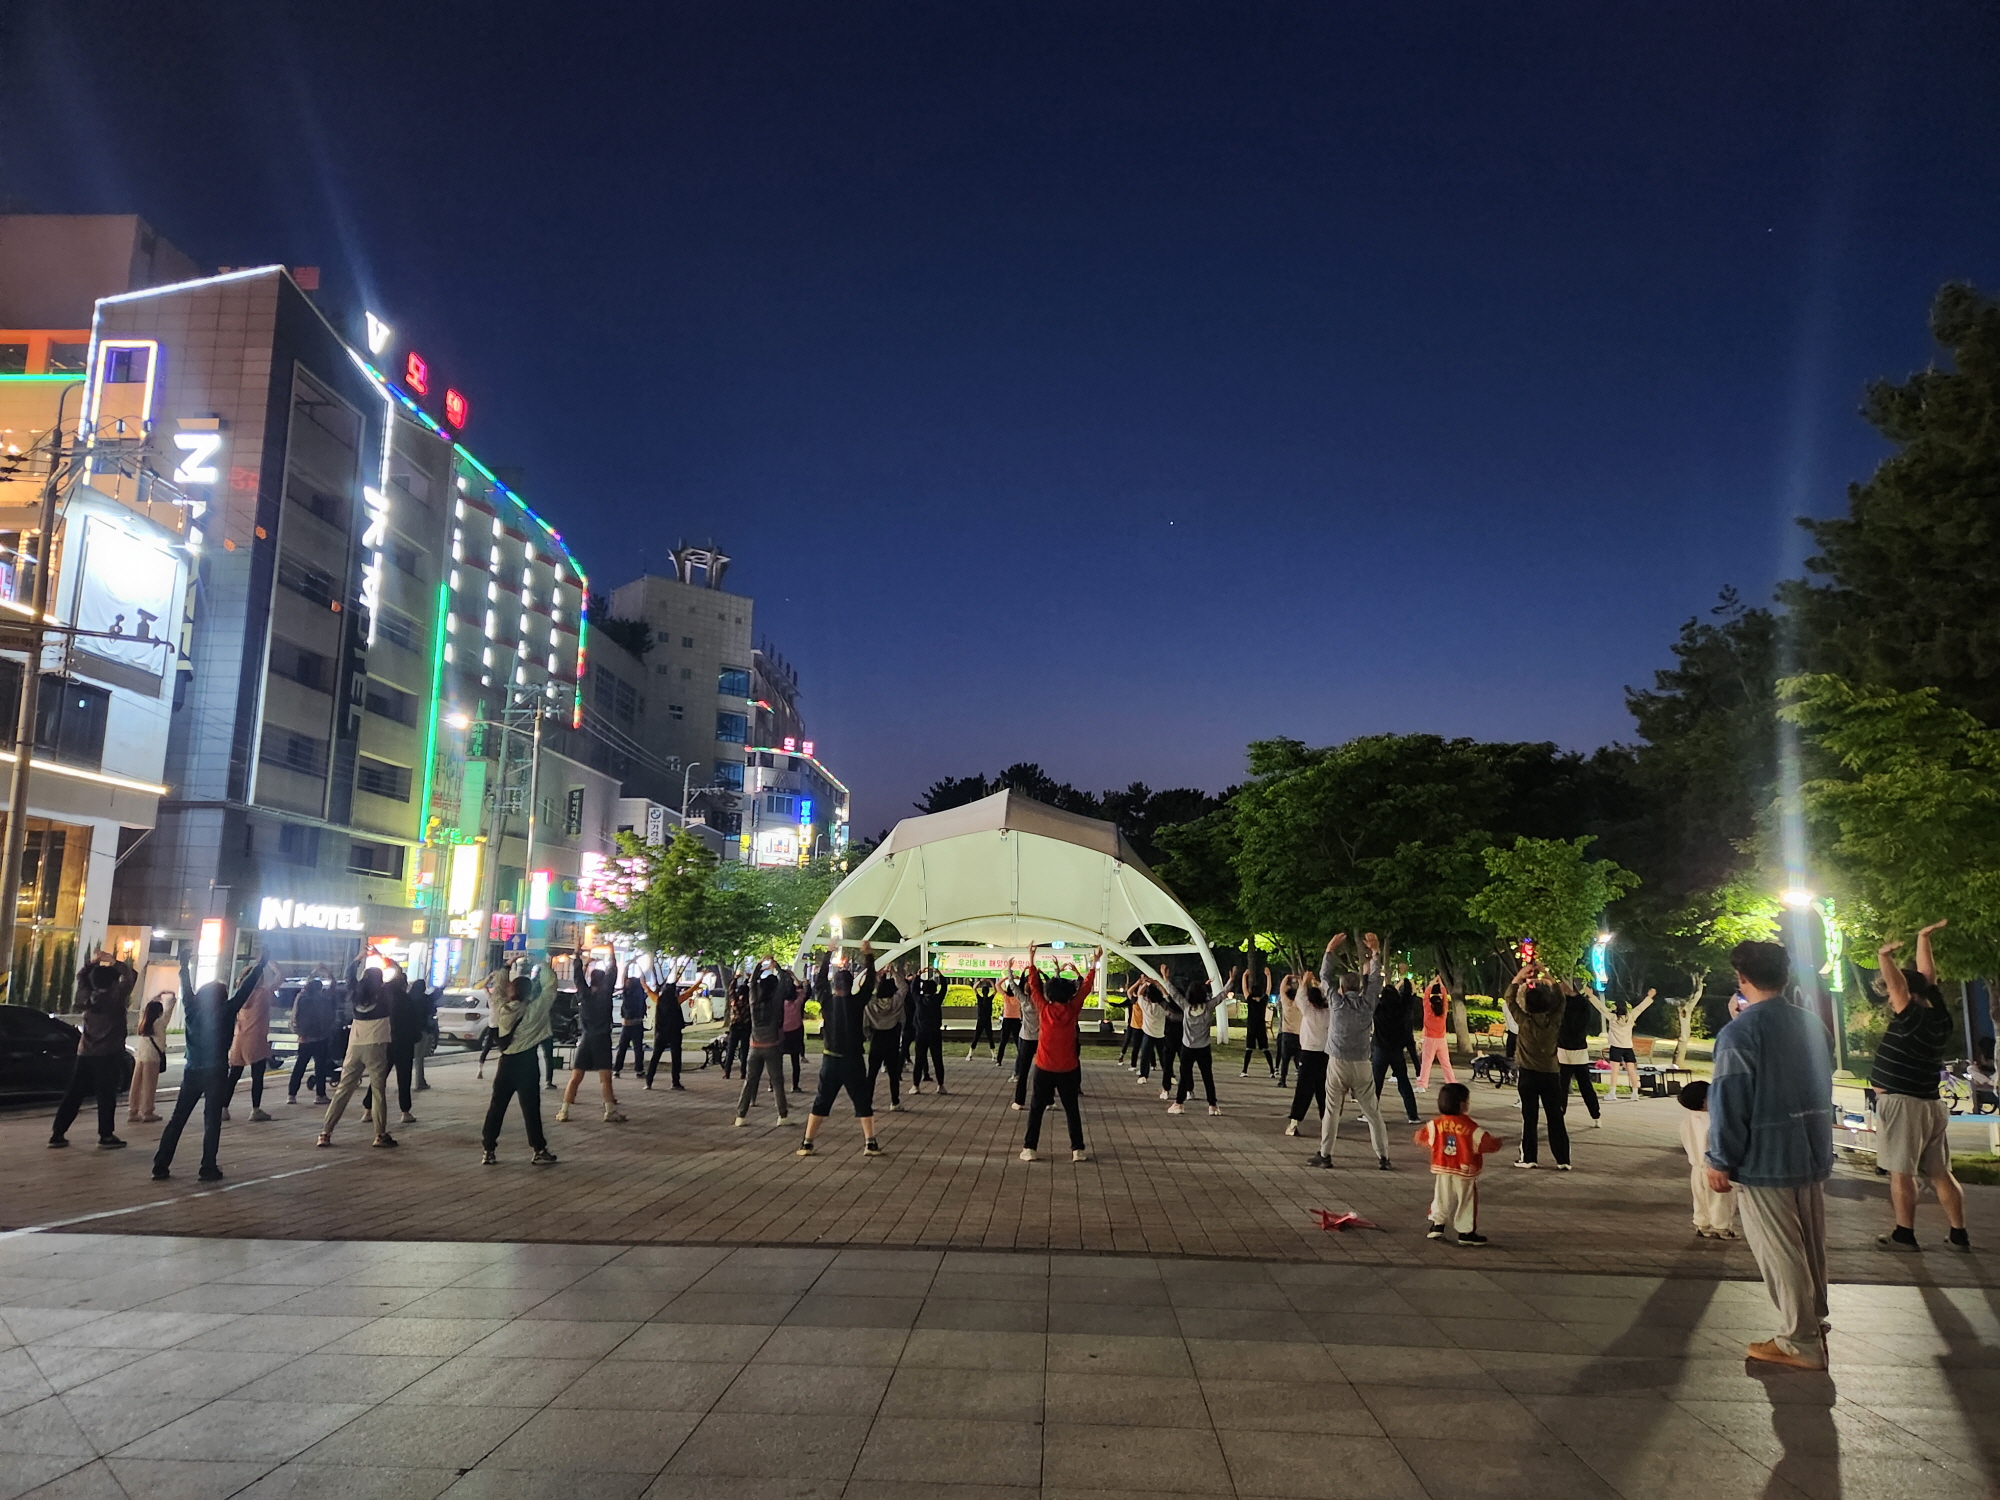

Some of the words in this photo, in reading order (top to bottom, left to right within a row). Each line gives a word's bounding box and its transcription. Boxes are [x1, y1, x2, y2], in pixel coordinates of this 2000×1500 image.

[365, 311, 391, 355] V
[798, 825, 812, 869] MOTE
[258, 897, 293, 931] IN
[293, 903, 365, 931] MOTEL
[958, 958, 986, 967] 우리동네
